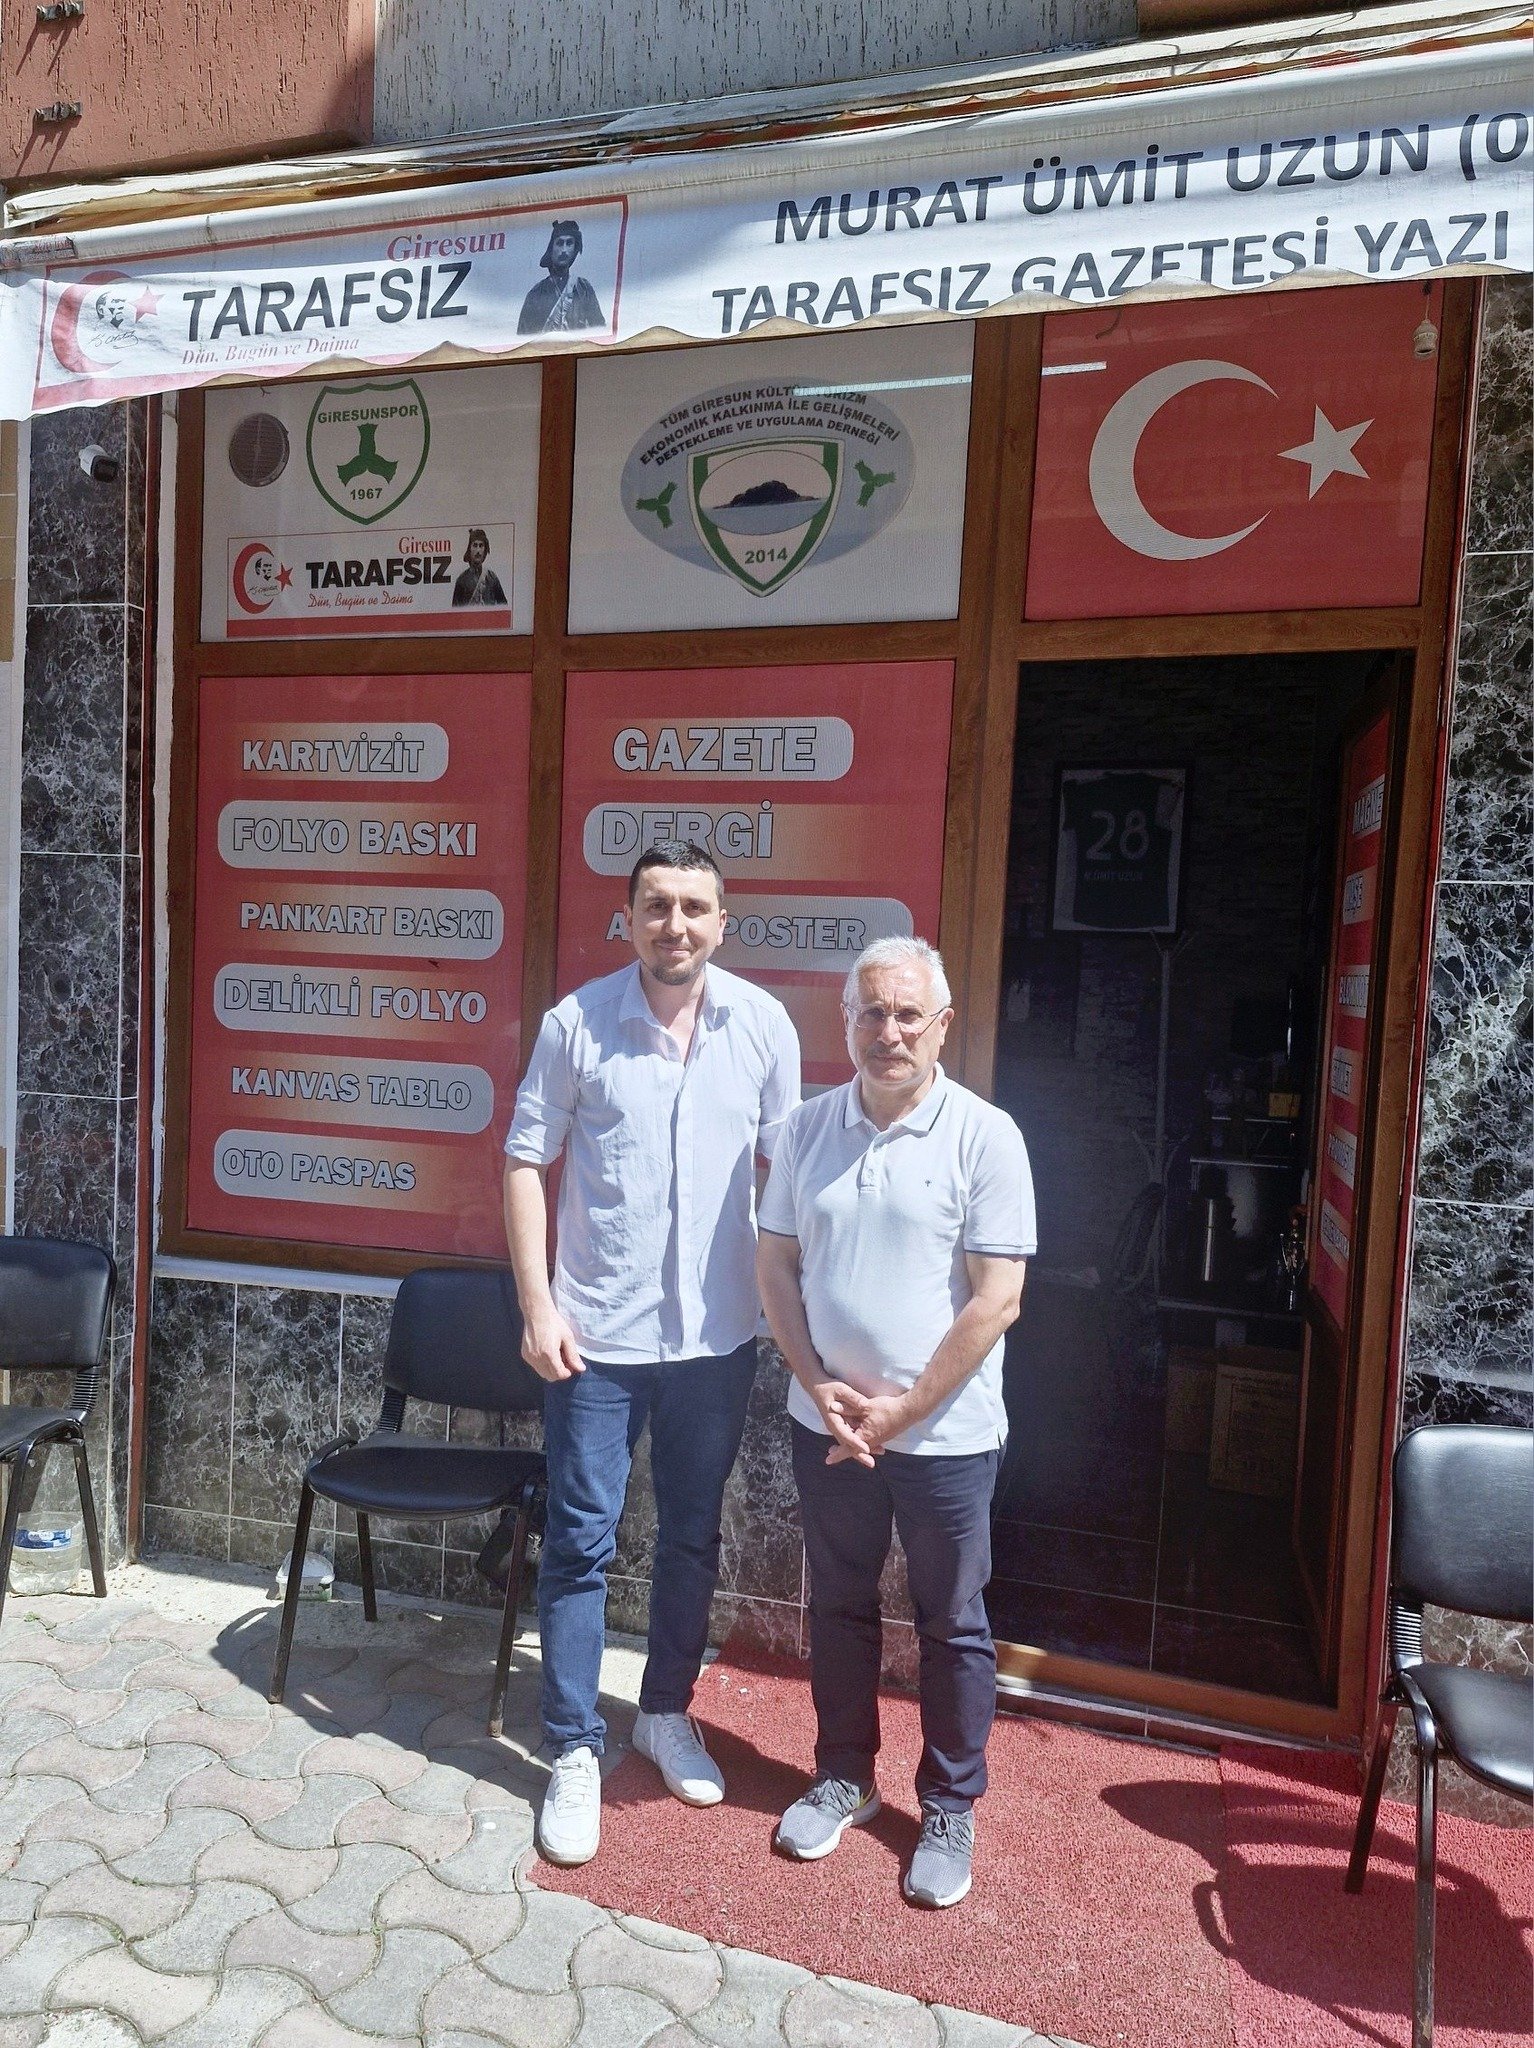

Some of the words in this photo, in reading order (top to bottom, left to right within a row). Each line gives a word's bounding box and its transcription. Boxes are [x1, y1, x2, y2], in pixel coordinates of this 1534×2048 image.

[774, 174, 1002, 244] MURAT
[1022, 144, 1202, 217] ÜMİT
[1226, 124, 1429, 192] UZUN
[386, 232, 506, 263] Giresun
[712, 262, 991, 334] TARAFSIZ
[1011, 215, 1329, 300] GAZETESİ
[1354, 210, 1509, 273] YAZI
[182, 261, 473, 342] TARAFSIZ
[306, 336, 360, 354] Daima
[659, 409, 690, 430] TÜM
[692, 391, 752, 413] GİRESUN
[640, 417, 709, 466] EKONOMİK
[712, 401, 784, 424] KALKINMA
[812, 400, 901, 442] GELİŞMELERİ
[656, 424, 733, 467] DESTEKLEME
[737, 419, 753, 431] VE
[756, 416, 823, 428] UYGULAMA
[827, 419, 882, 446] DERNEĞİ
[350, 487, 383, 500] 1967
[399, 536, 451, 554] Giresun
[744, 547, 788, 565] 2014
[306, 556, 452, 588] TARAFSIZ
[335, 593, 366, 611] Bugün
[381, 591, 414, 606] Daima
[242, 731, 425, 773] KARTVİZİT
[612, 726, 817, 772] GAZETE
[233, 818, 349, 854] FOLYO
[359, 820, 478, 857] BASKI
[601, 799, 774, 859] DERGİ
[1086, 809, 1149, 861] 28
[240, 902, 387, 935] PANKART
[393, 907, 493, 940] BASKI
[721, 914, 866, 950] POSTER
[223, 973, 361, 1017] DELİKLİ
[371, 986, 488, 1024] FOLYO
[231, 1067, 360, 1103] KANVAS
[367, 1075, 472, 1111] TABLO
[222, 1148, 284, 1178] OTO
[291, 1153, 417, 1191] PASPAS
